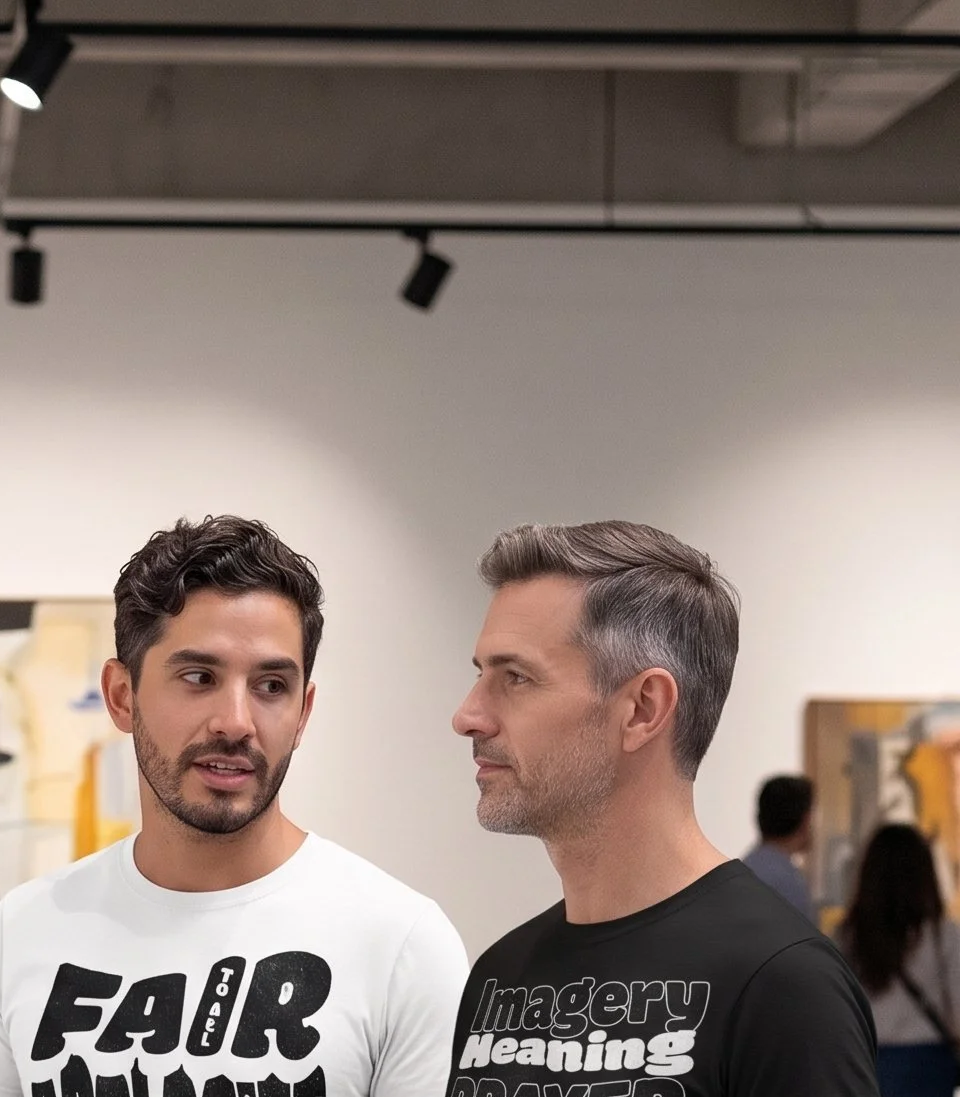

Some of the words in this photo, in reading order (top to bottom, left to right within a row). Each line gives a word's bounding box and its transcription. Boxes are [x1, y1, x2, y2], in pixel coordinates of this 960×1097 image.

[30, 951, 332, 1061] FAIR
[471, 977, 710, 1038] Imagery
[459, 1029, 696, 1076] Meaning
